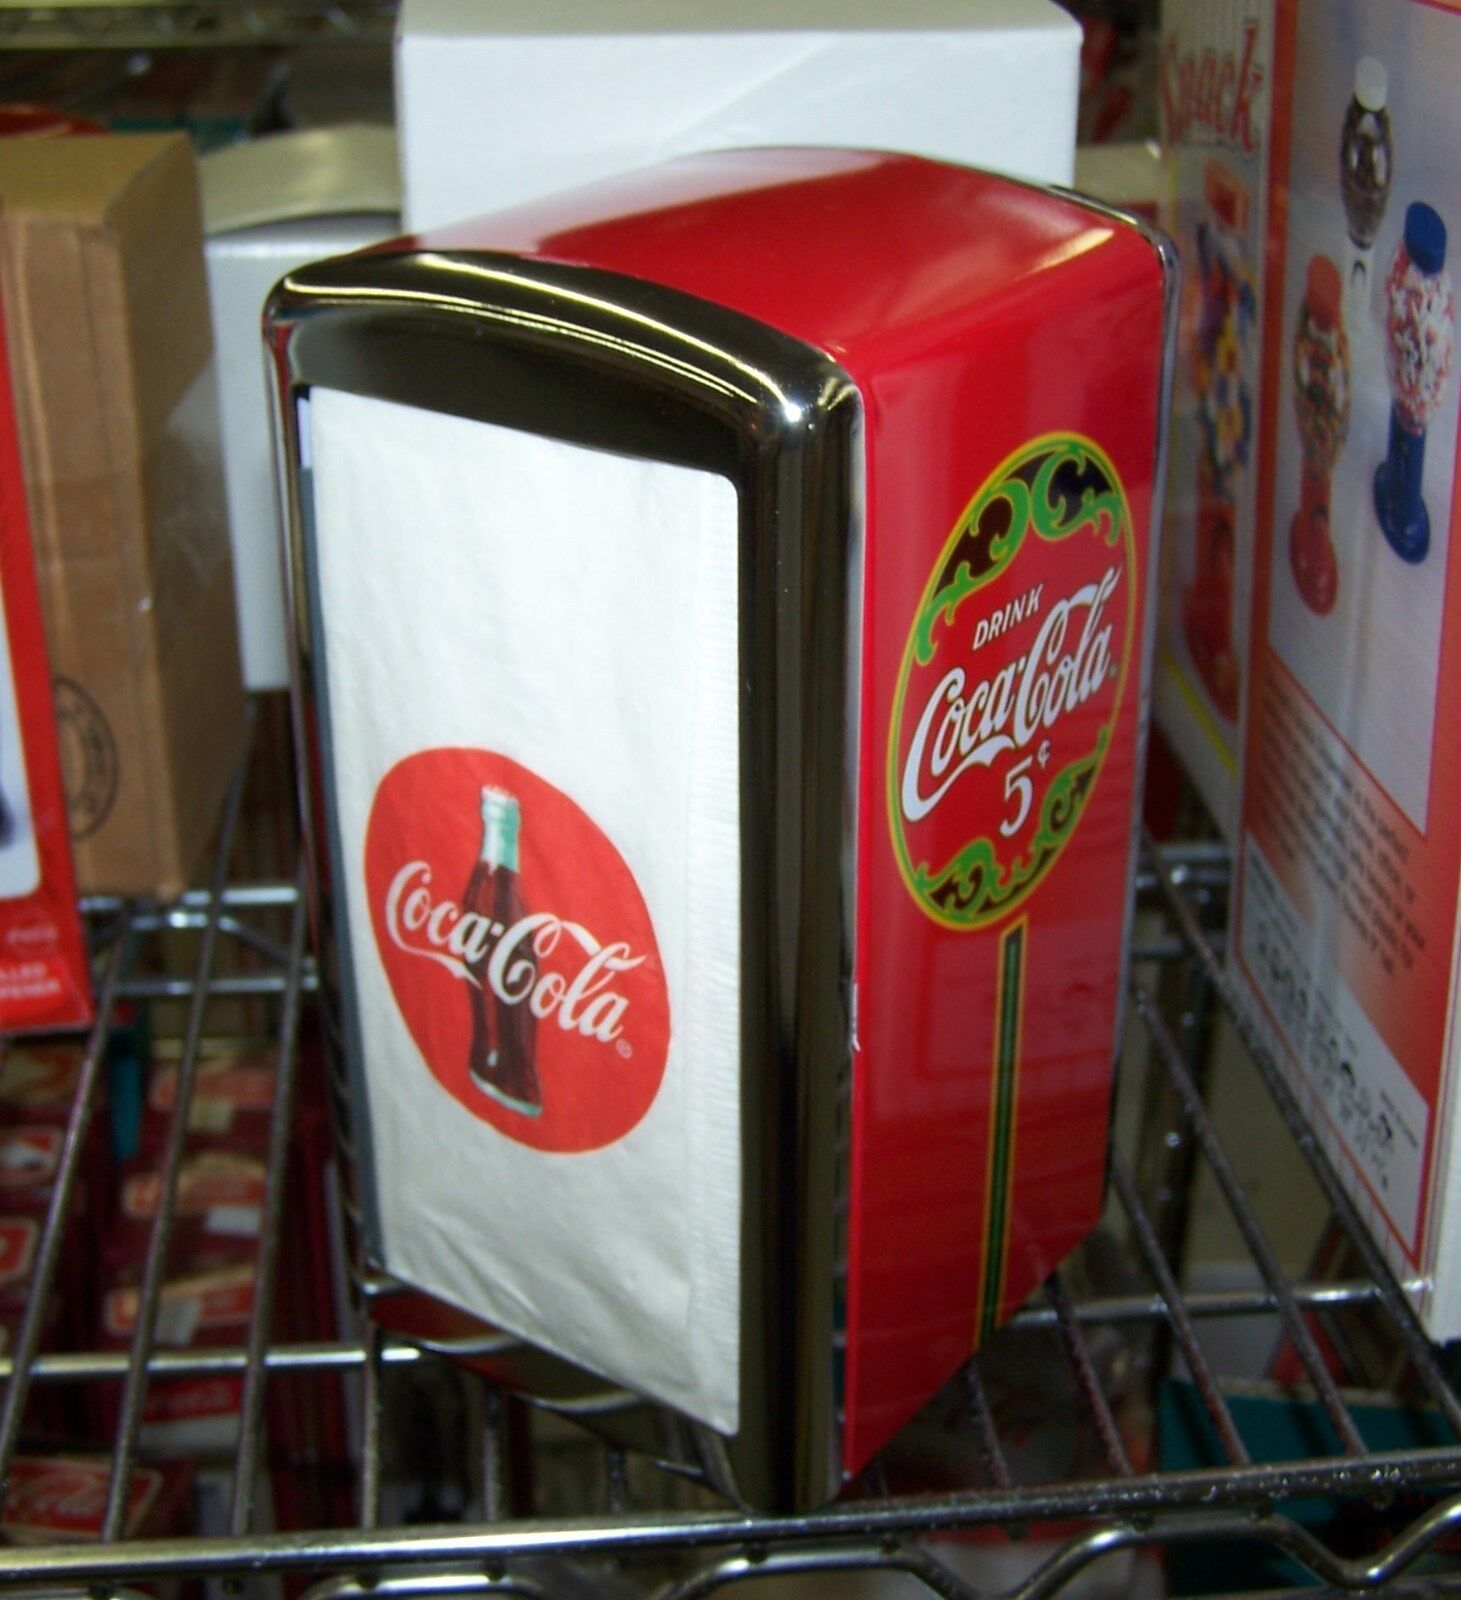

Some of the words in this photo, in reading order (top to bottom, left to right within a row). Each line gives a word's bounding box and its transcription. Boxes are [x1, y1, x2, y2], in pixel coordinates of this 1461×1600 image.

[902, 564, 1122, 822] Coca-Cola
[972, 583, 1043, 650] DRINK
[385, 860, 647, 1042] Coca-Cola
